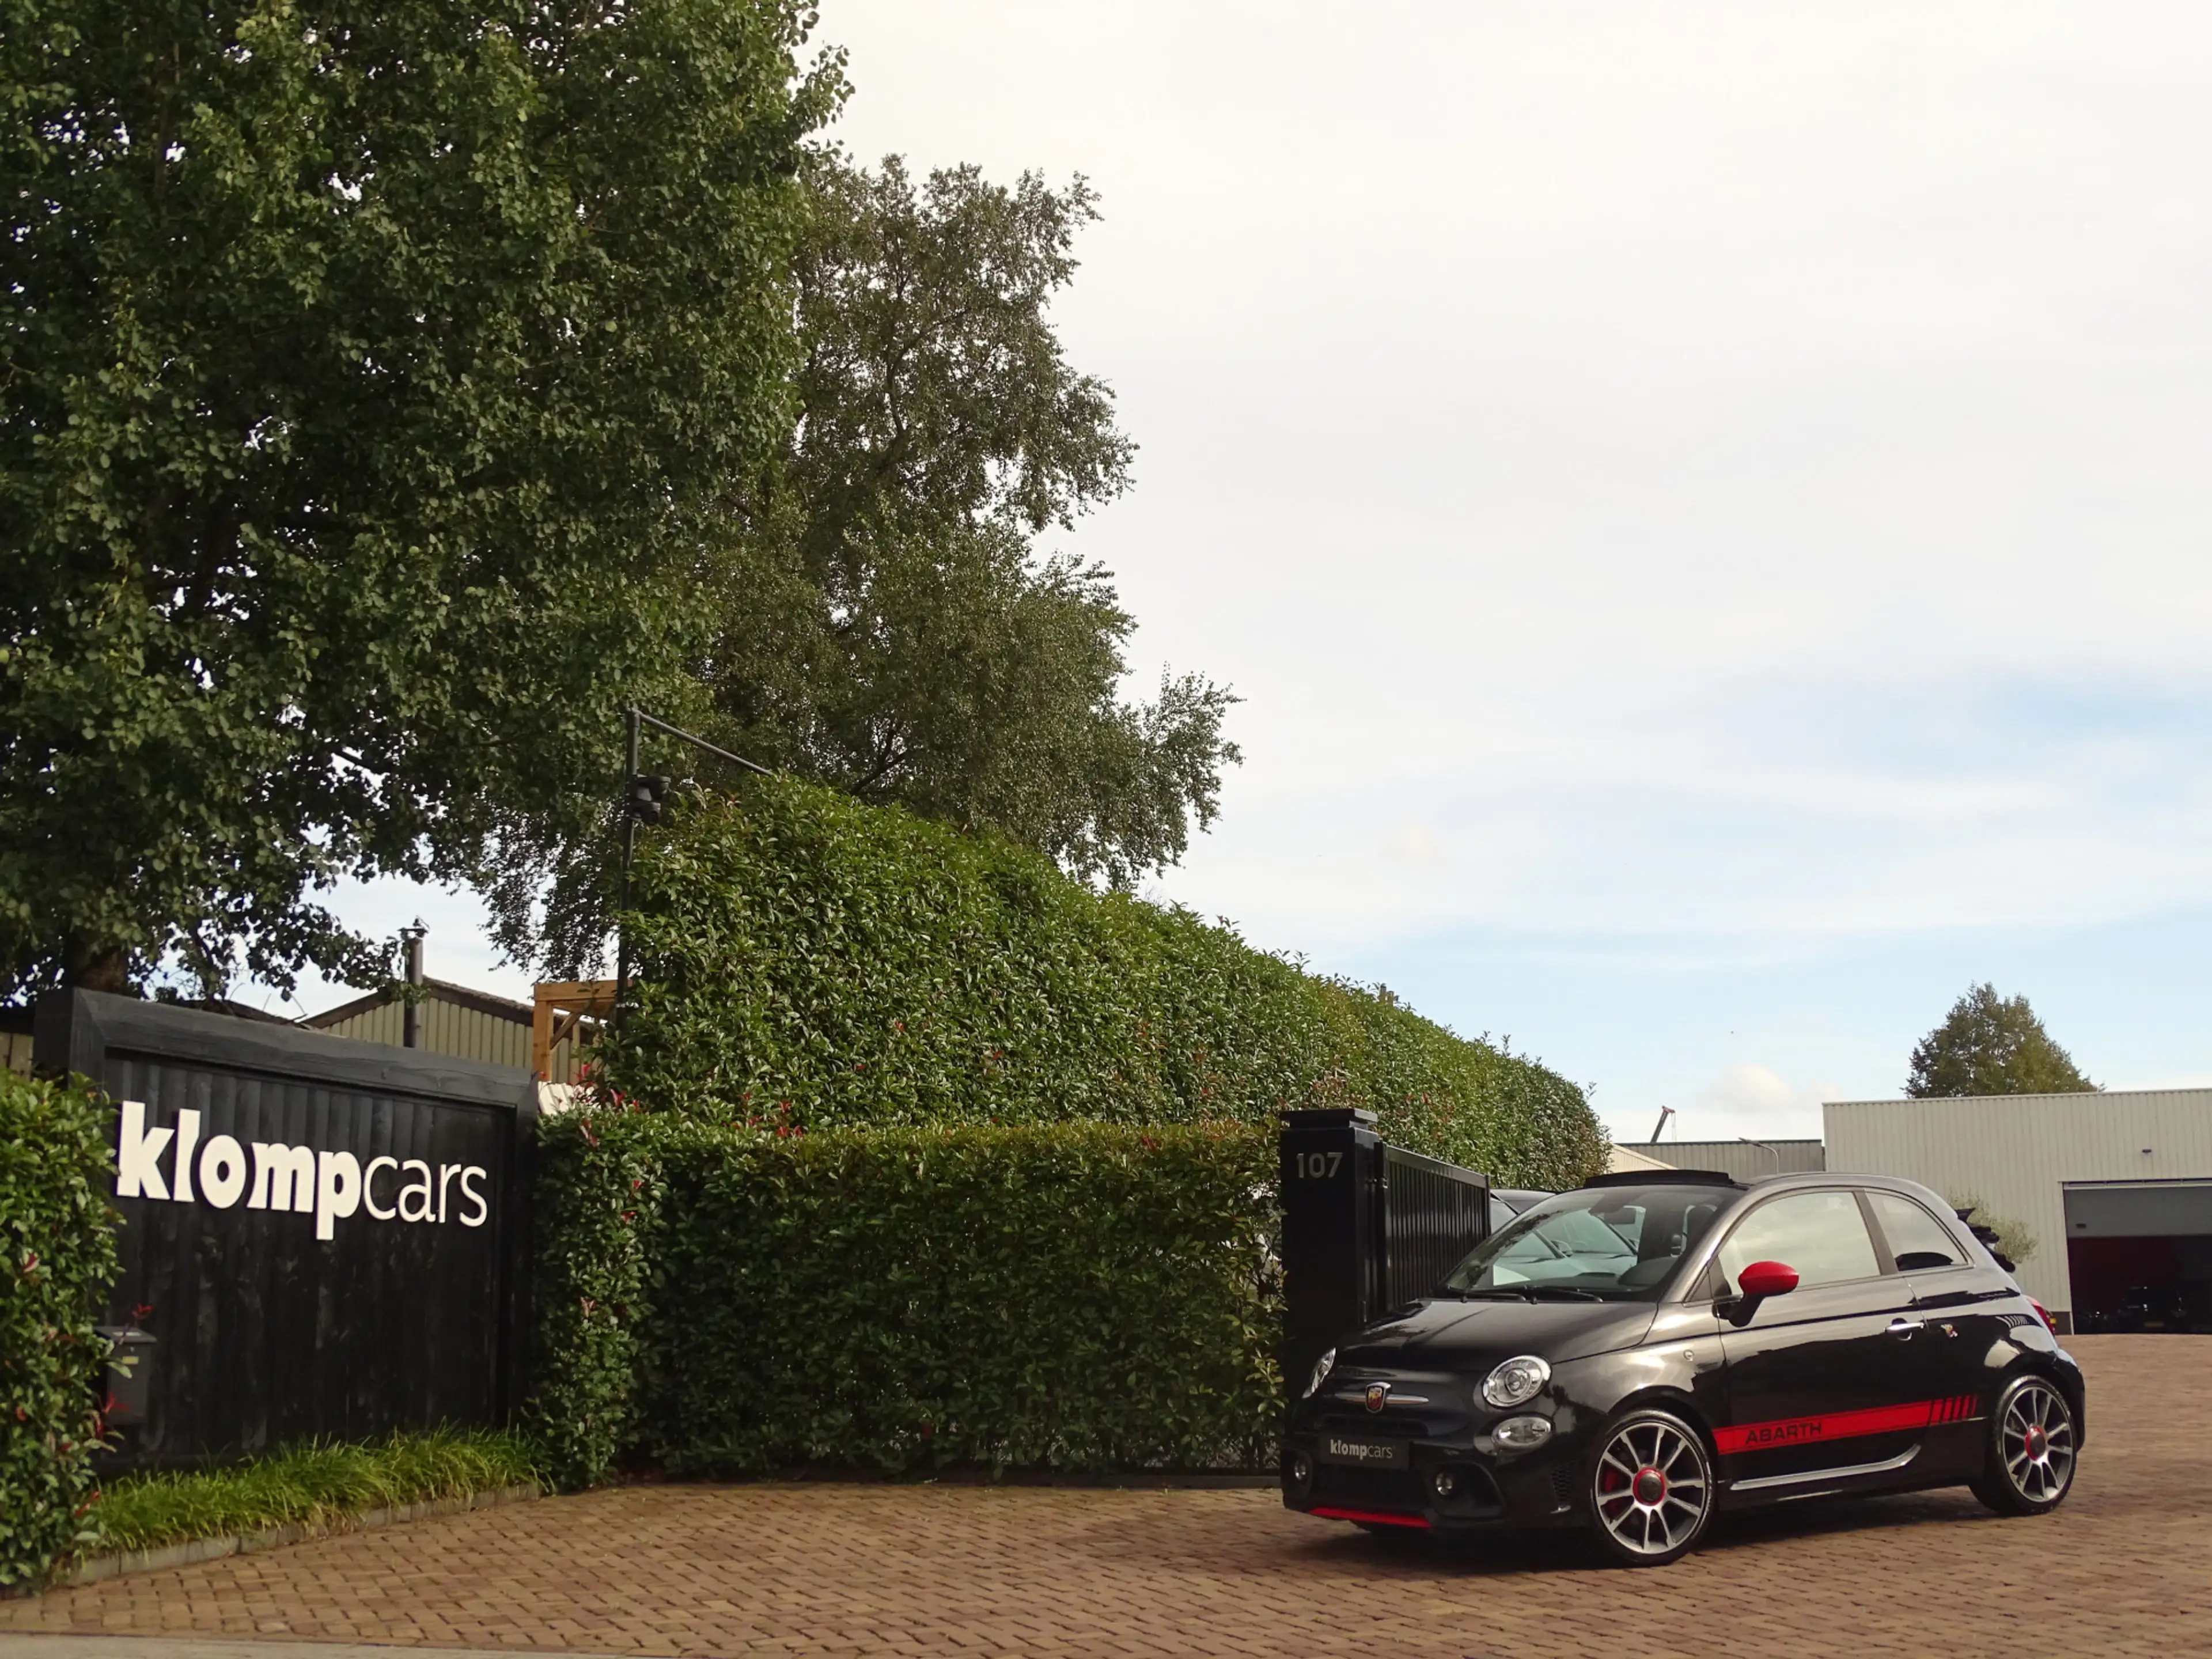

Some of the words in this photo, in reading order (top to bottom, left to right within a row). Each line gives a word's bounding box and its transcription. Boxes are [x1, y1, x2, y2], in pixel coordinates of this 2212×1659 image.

[117, 1100, 487, 1240] klompcars
[1297, 1152, 1343, 1178] 107
[1745, 1422, 1821, 1444] ABARTH
[1330, 1439, 1393, 1460] klompcars
